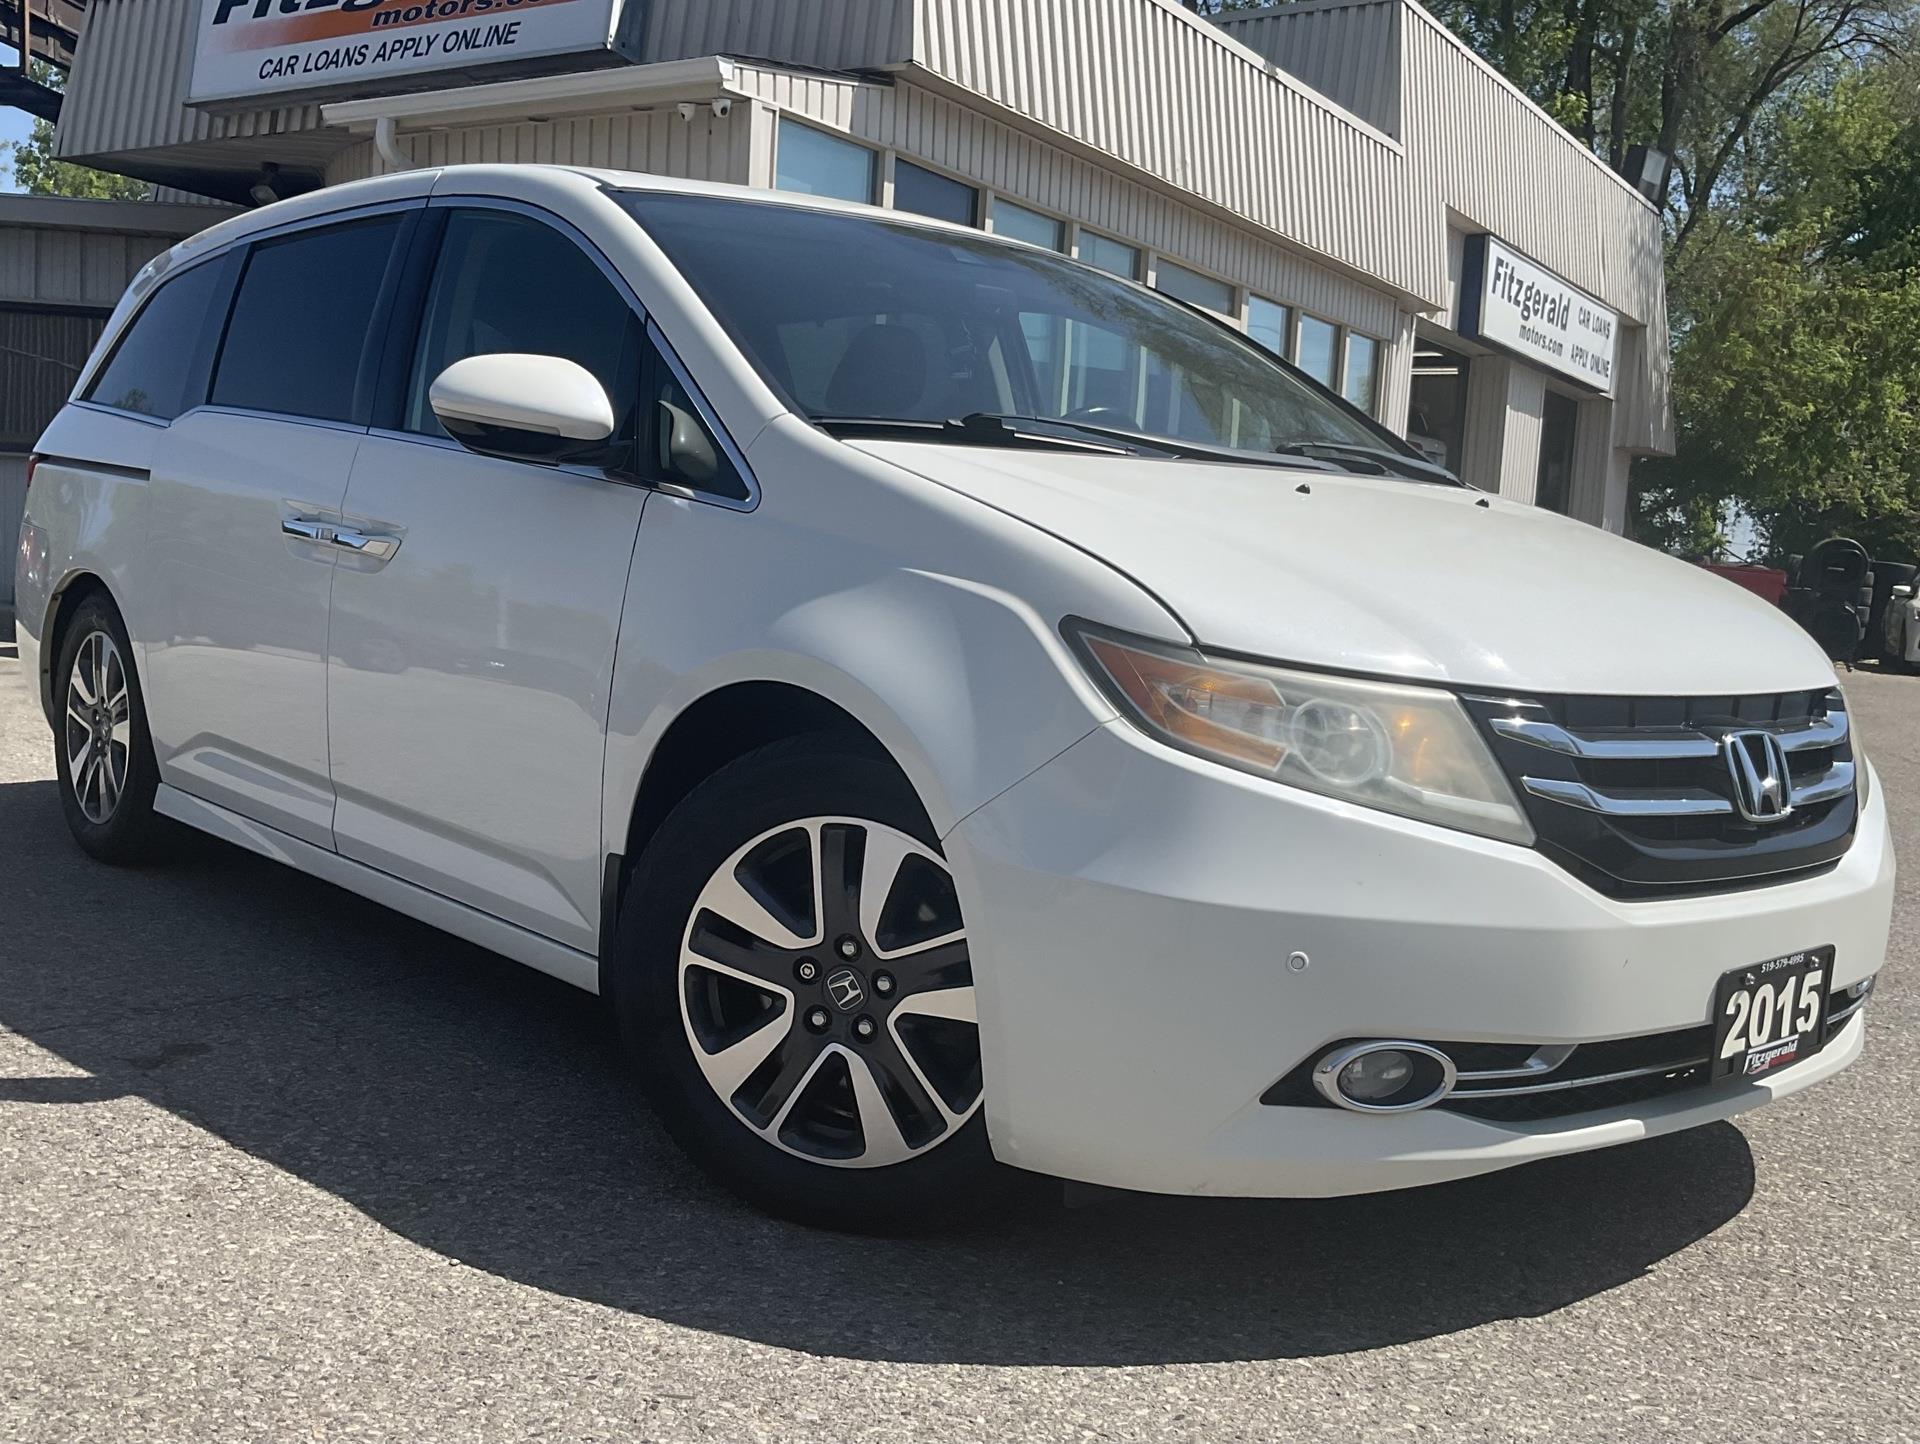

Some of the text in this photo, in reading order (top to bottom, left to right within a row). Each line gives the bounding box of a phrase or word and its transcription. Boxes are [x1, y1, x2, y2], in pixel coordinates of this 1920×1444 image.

[258, 21, 521, 80] CAR LOANS APPLY ONLINE
[1491, 256, 1571, 331] Fitzgerald
[1519, 324, 1563, 357] motors.com
[1578, 306, 1611, 340] CAR LOANS
[1571, 343, 1610, 378] APPLY ONLINE
[1720, 969, 1823, 1059] 2015
[1743, 1039, 1798, 1075] Fitzgerald
